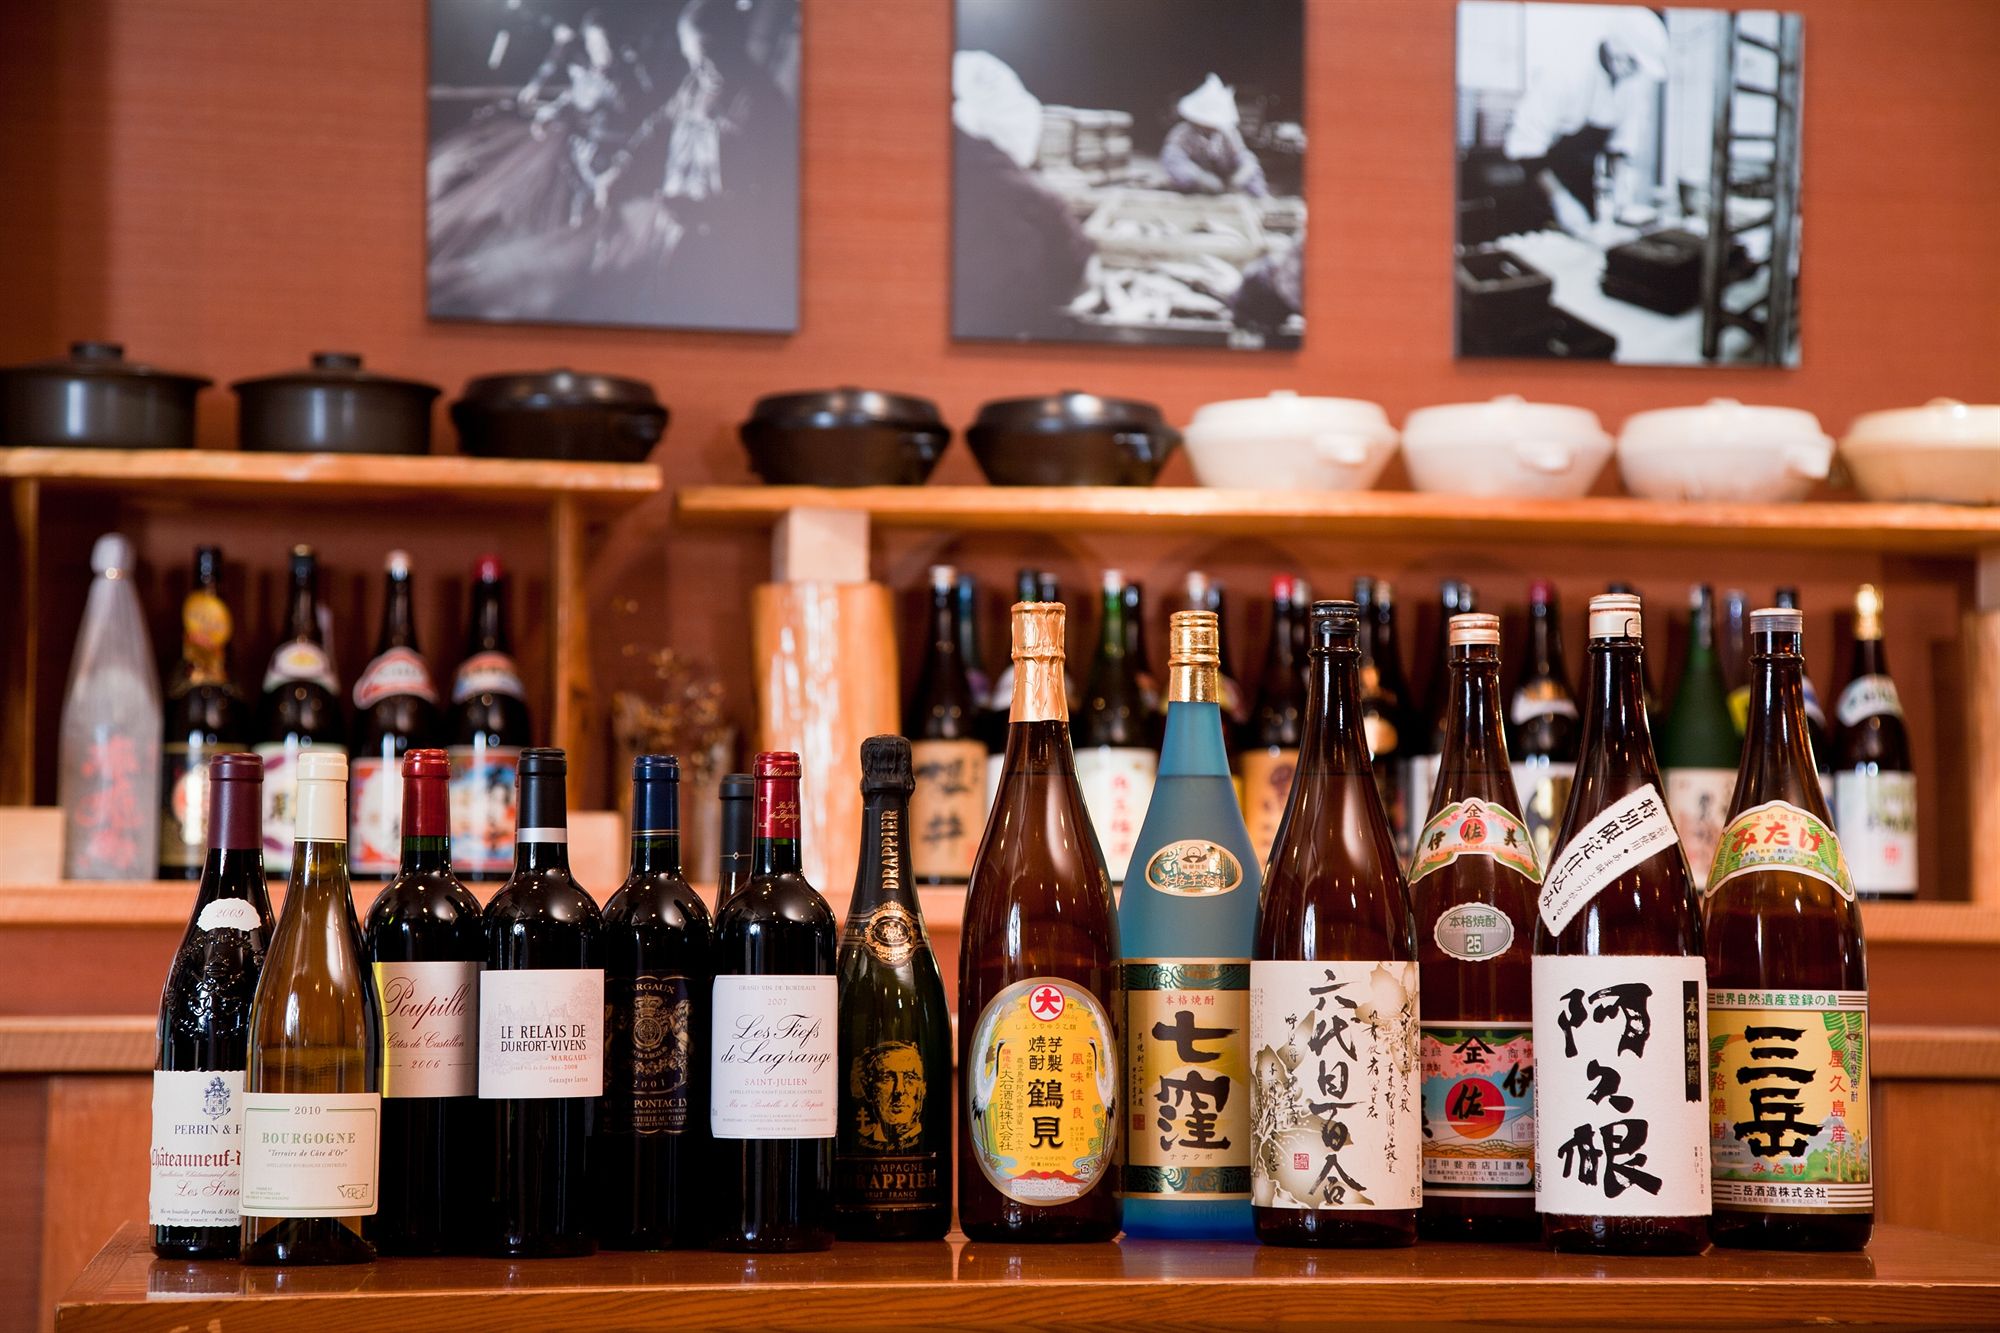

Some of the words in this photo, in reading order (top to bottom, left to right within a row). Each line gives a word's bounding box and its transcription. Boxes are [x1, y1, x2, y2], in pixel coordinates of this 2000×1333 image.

[1731, 821, 1824, 853] みたけ
[881, 809, 900, 890] DRAPPIER
[1543, 798, 1659, 909] 特別限定仕込み
[215, 909, 244, 919] 2009
[1449, 914, 1497, 929] 本格焼酎
[1467, 935, 1481, 953] 25
[382, 976, 471, 1030] Poupille
[767, 998, 788, 1006] 2007
[1035, 988, 1061, 1014] 大
[1166, 995, 1215, 1006] 本格焼酎
[1715, 992, 1838, 1007] 世界自然遺産登録の島
[501, 1026, 514, 1039] LE
[521, 1025, 567, 1039] RELAIS
[572, 1024, 586, 1038] DE
[731, 1014, 770, 1039] Les
[774, 1013, 823, 1049] Fiefs
[500, 1040, 587, 1052] DURFORT-VIVENS
[410, 1059, 441, 1069] 2006
[720, 1044, 735, 1063] de
[737, 1039, 832, 1074] Lagrange
[744, 1078, 808, 1087] SAINT-JULIEN
[1070, 1052, 1084, 1120] 風味佳良
[1151, 1010, 1241, 1151] 七窪
[1308, 968, 1367, 1205] 六代目百合
[1557, 982, 1663, 1199] 阿久根
[1733, 1025, 1825, 1157] 三岳
[1829, 1050, 1847, 1143] 屋久島産
[294, 1106, 321, 1115] 2010
[634, 1098, 676, 1108] PONTAC
[999, 1070, 1014, 1152] 大石酒造株式会社
[174, 1124, 219, 1135] PERRIN
[222, 1124, 231, 1135] &
[261, 1132, 356, 1144] BOURGOGNE
[299, 1149, 307, 1157] de
[1441, 1160, 1490, 1171] 甲斐商店
[1752, 1161, 1805, 1175] みたけ
[1733, 1184, 1827, 1199] 三岳酒造株式会社
